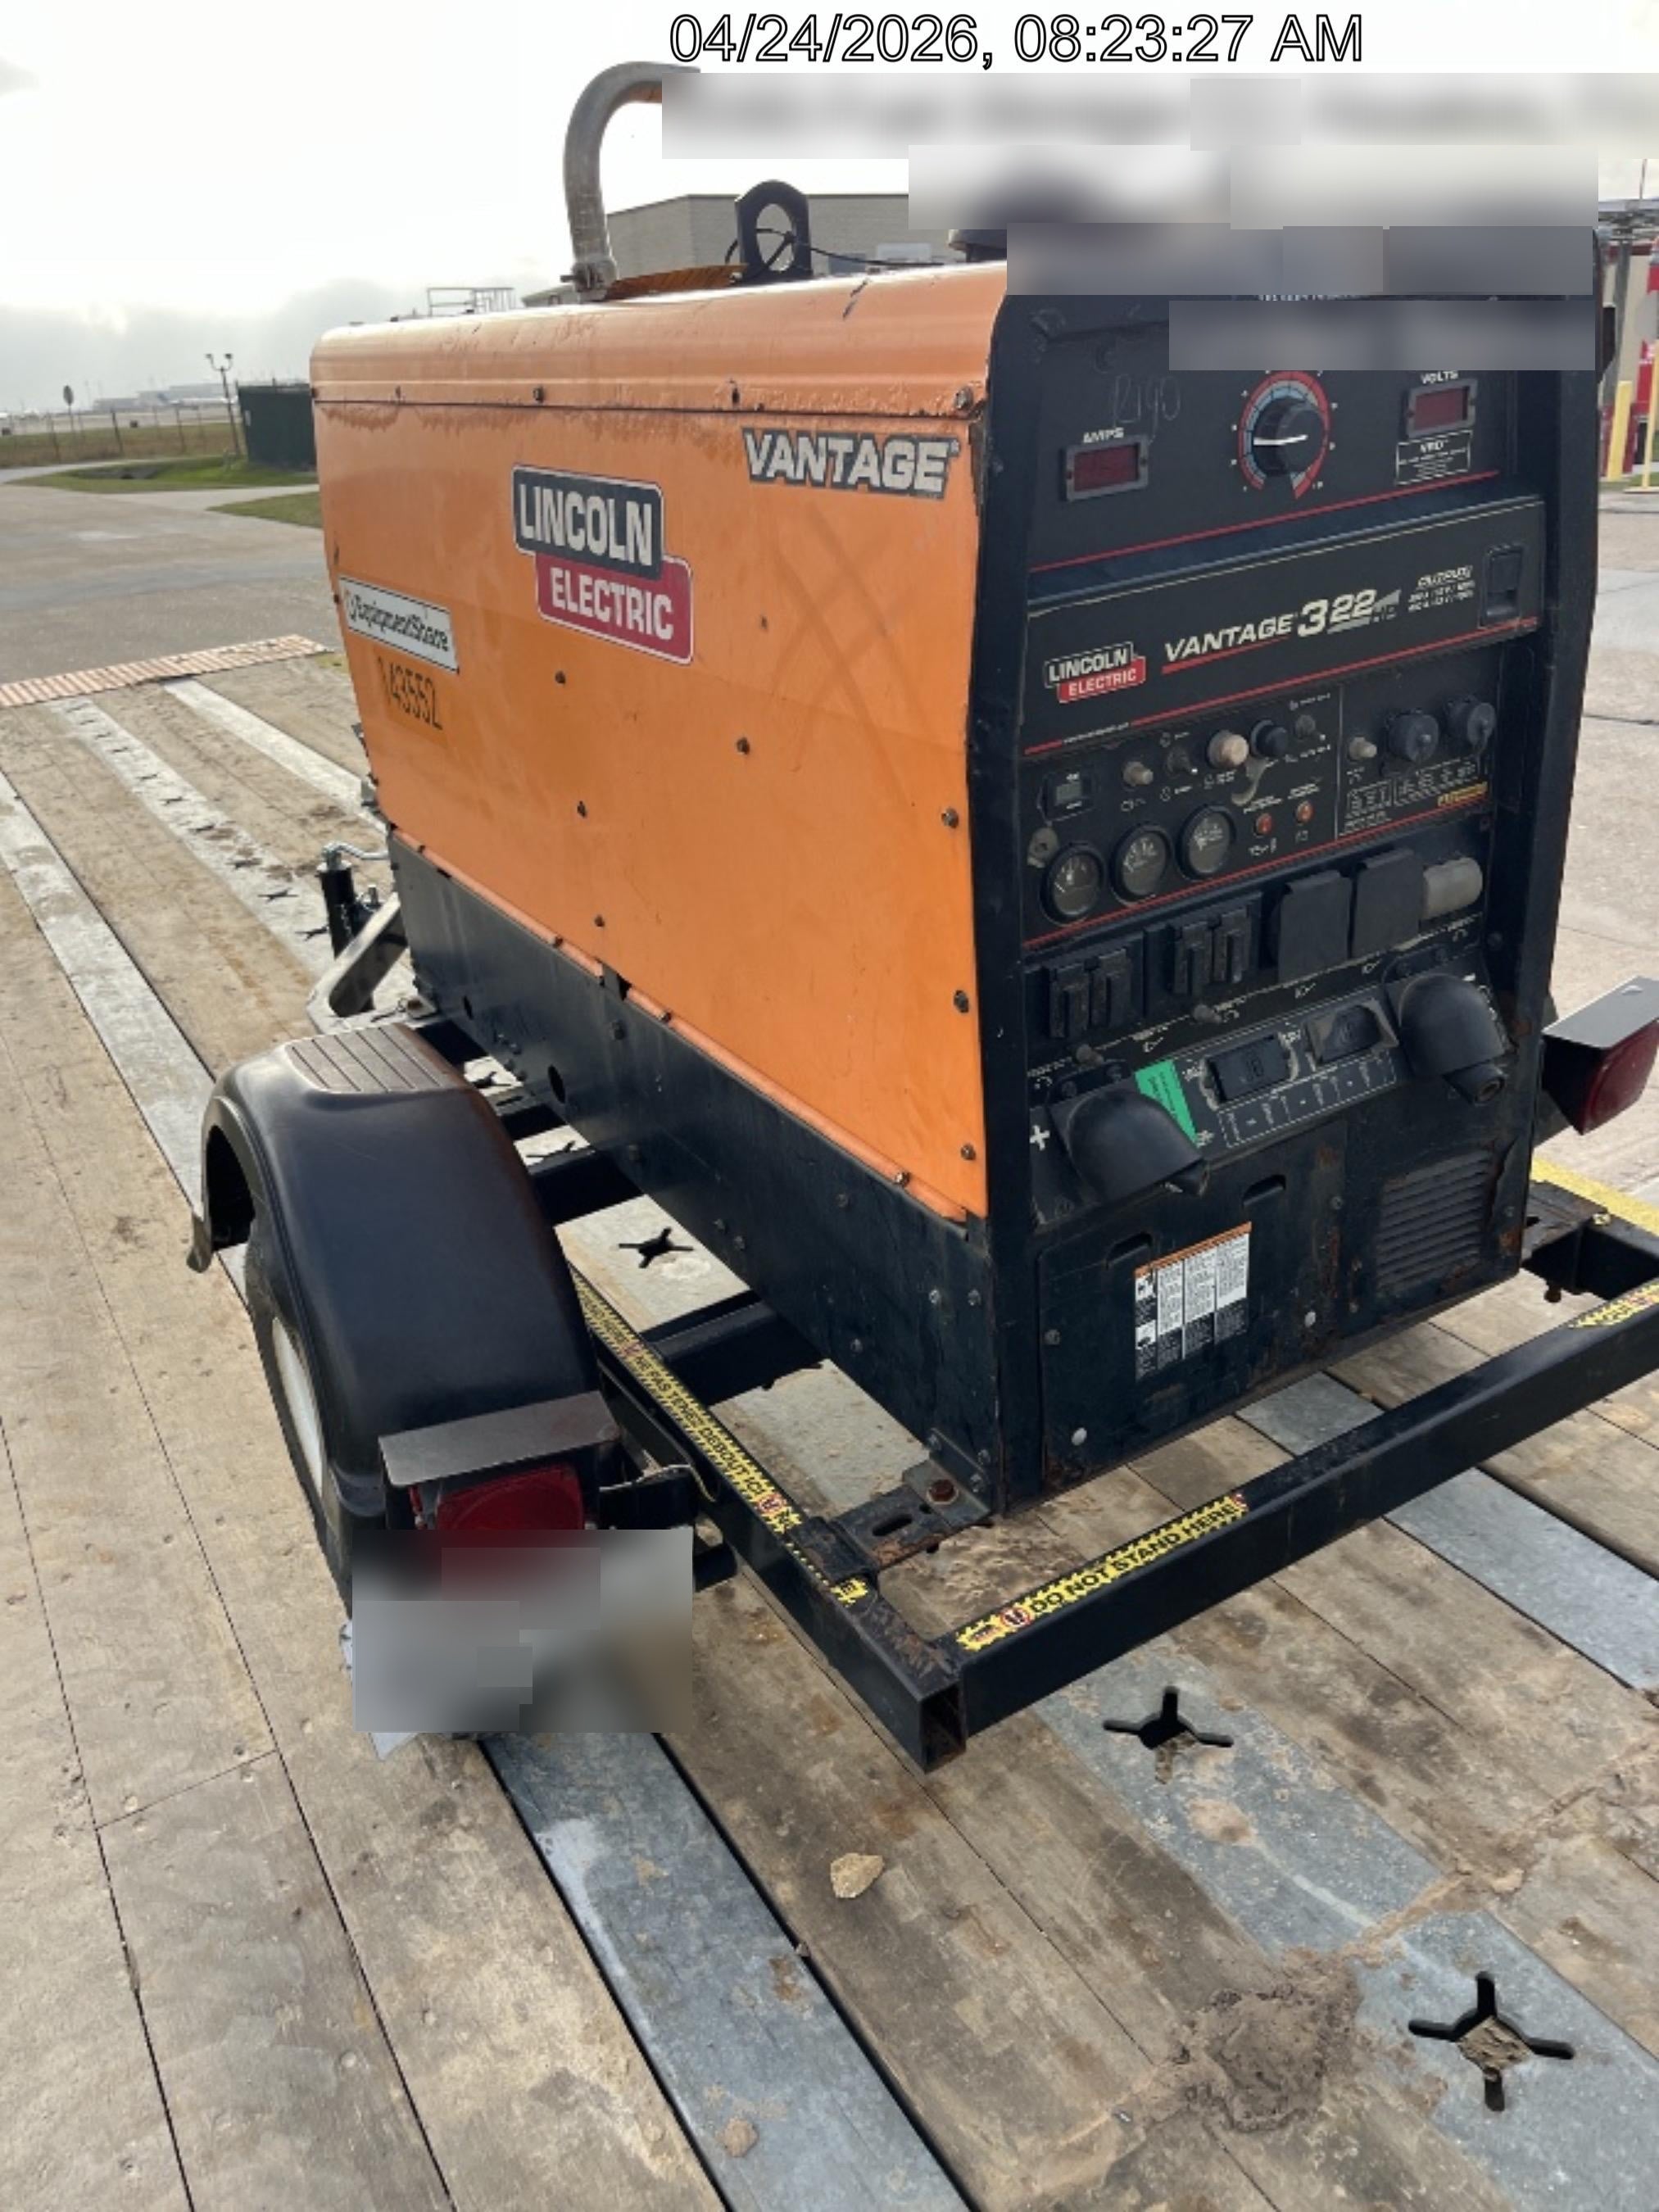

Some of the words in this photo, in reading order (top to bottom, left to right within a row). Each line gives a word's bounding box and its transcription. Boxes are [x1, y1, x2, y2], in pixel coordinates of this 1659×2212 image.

[745, 433, 949, 493] VANTAGE
[1083, 427, 1125, 443] AMPS
[519, 483, 653, 566] LINCOLN
[550, 565, 674, 641] ELECTRIC
[1164, 614, 1294, 663] VANTAGE
[1297, 588, 1378, 637] 322
[1049, 647, 1128, 682] LINCOLN
[1068, 669, 1138, 696] ELECTRIC
[1030, 1591, 1064, 1613] DO
[1064, 1566, 1111, 1596] NOT
[1111, 1533, 1181, 1571] STAND
